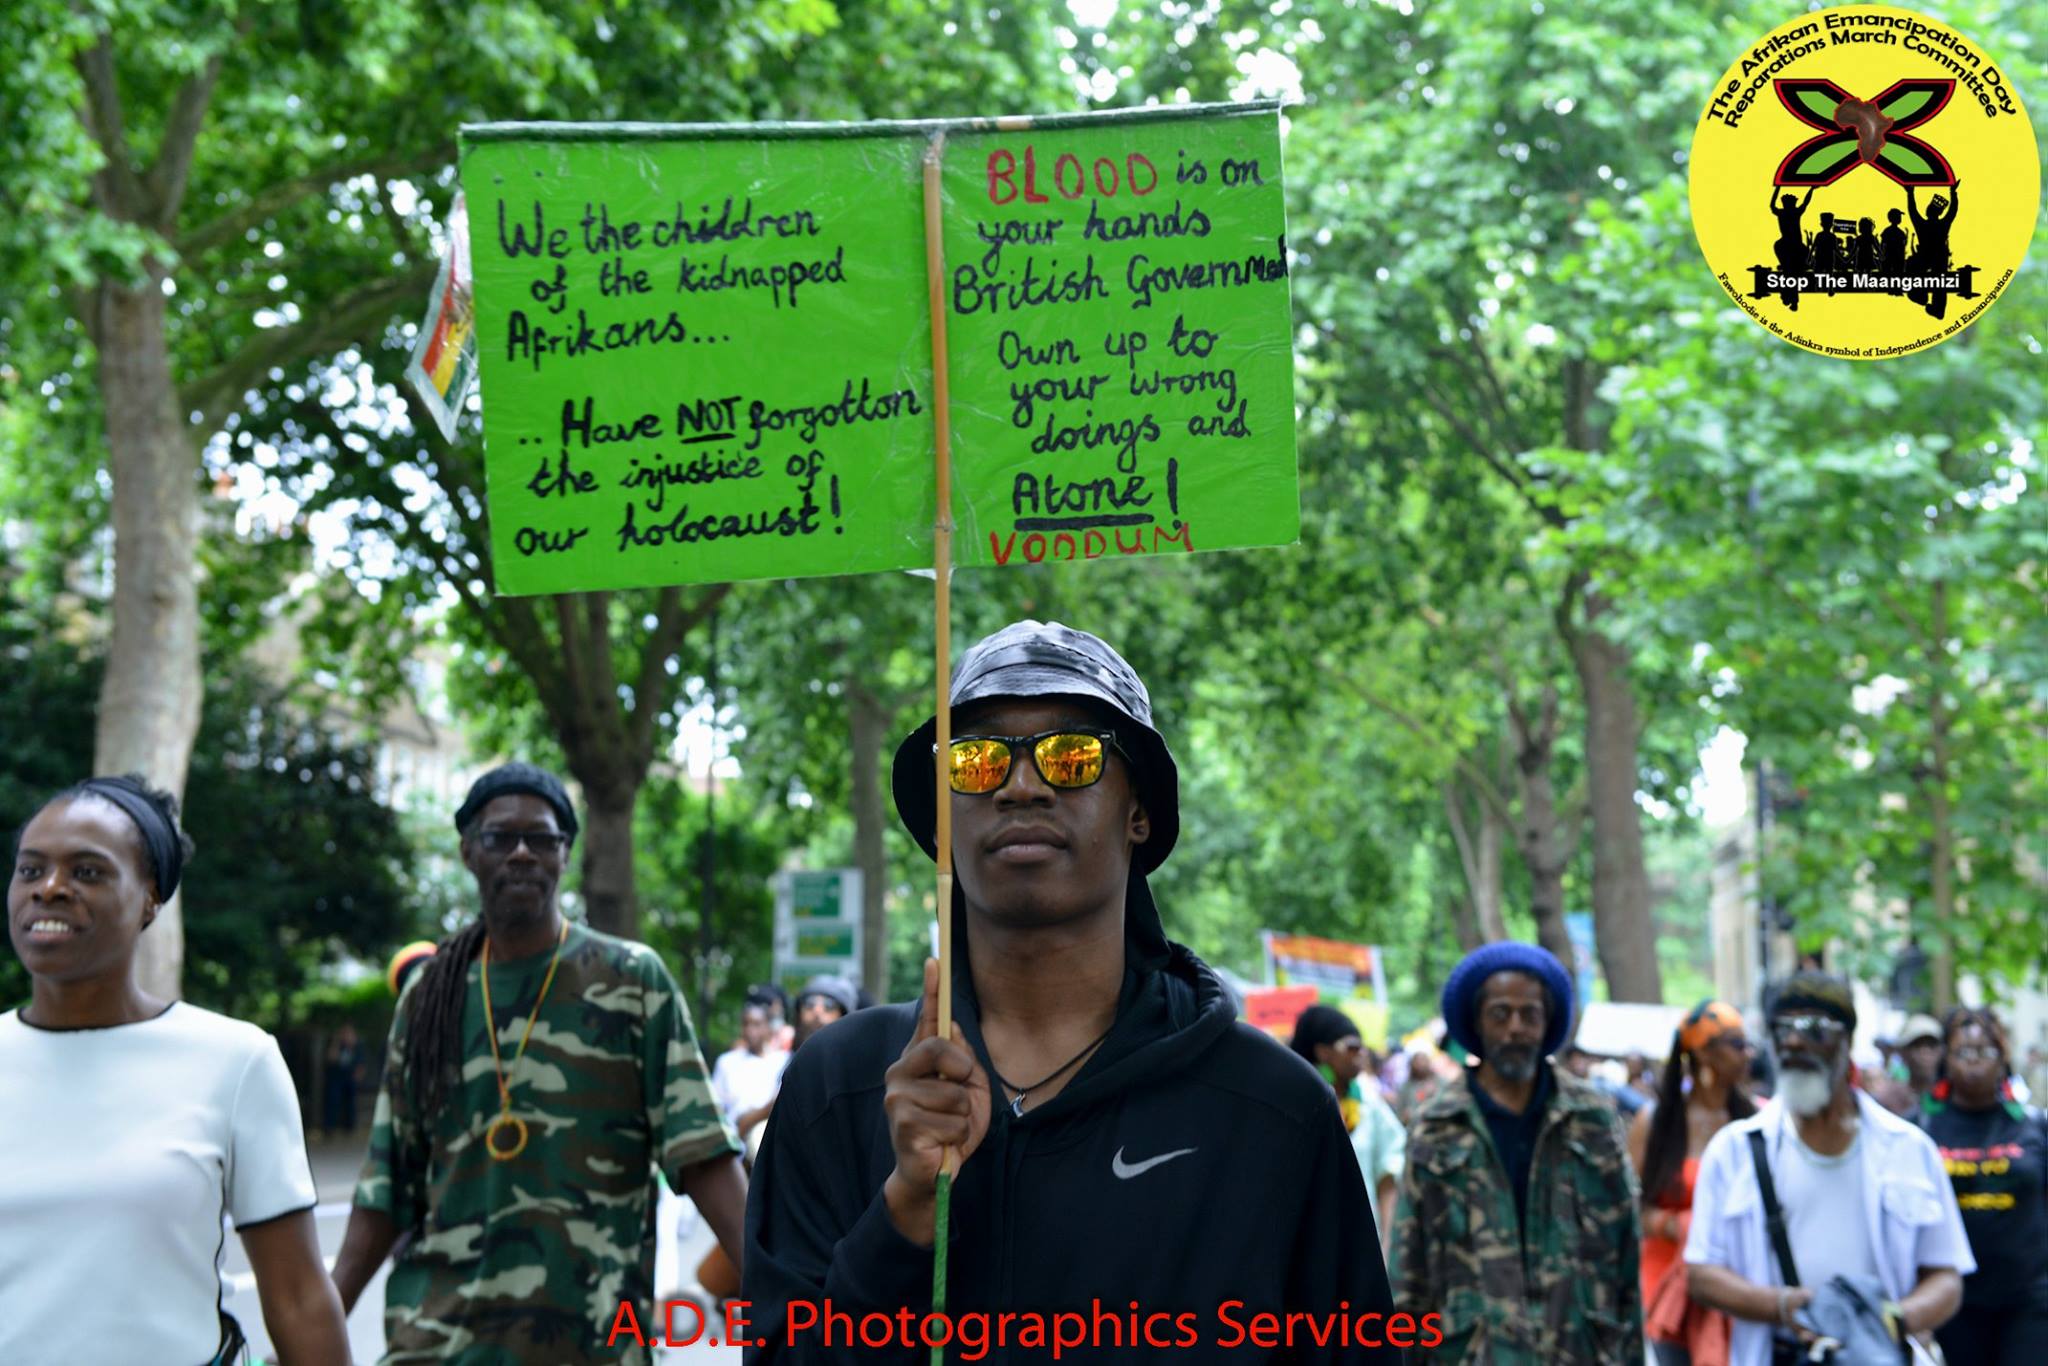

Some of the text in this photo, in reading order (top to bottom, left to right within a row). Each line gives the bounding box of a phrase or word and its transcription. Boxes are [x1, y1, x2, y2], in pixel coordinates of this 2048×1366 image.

[987, 145, 1264, 205] BLOOD is on
[498, 195, 819, 258] We the children
[978, 200, 1211, 278] your hands
[530, 265, 567, 314] of
[600, 256, 653, 295] the
[953, 256, 1109, 314] British
[1000, 315, 1218, 370] Own up to
[676, 396, 741, 432] NOT
[1010, 374, 1110, 428] your
[1030, 400, 1251, 473] doings and
[528, 450, 825, 511] the injustice of
[513, 475, 844, 556] our holocaust!
